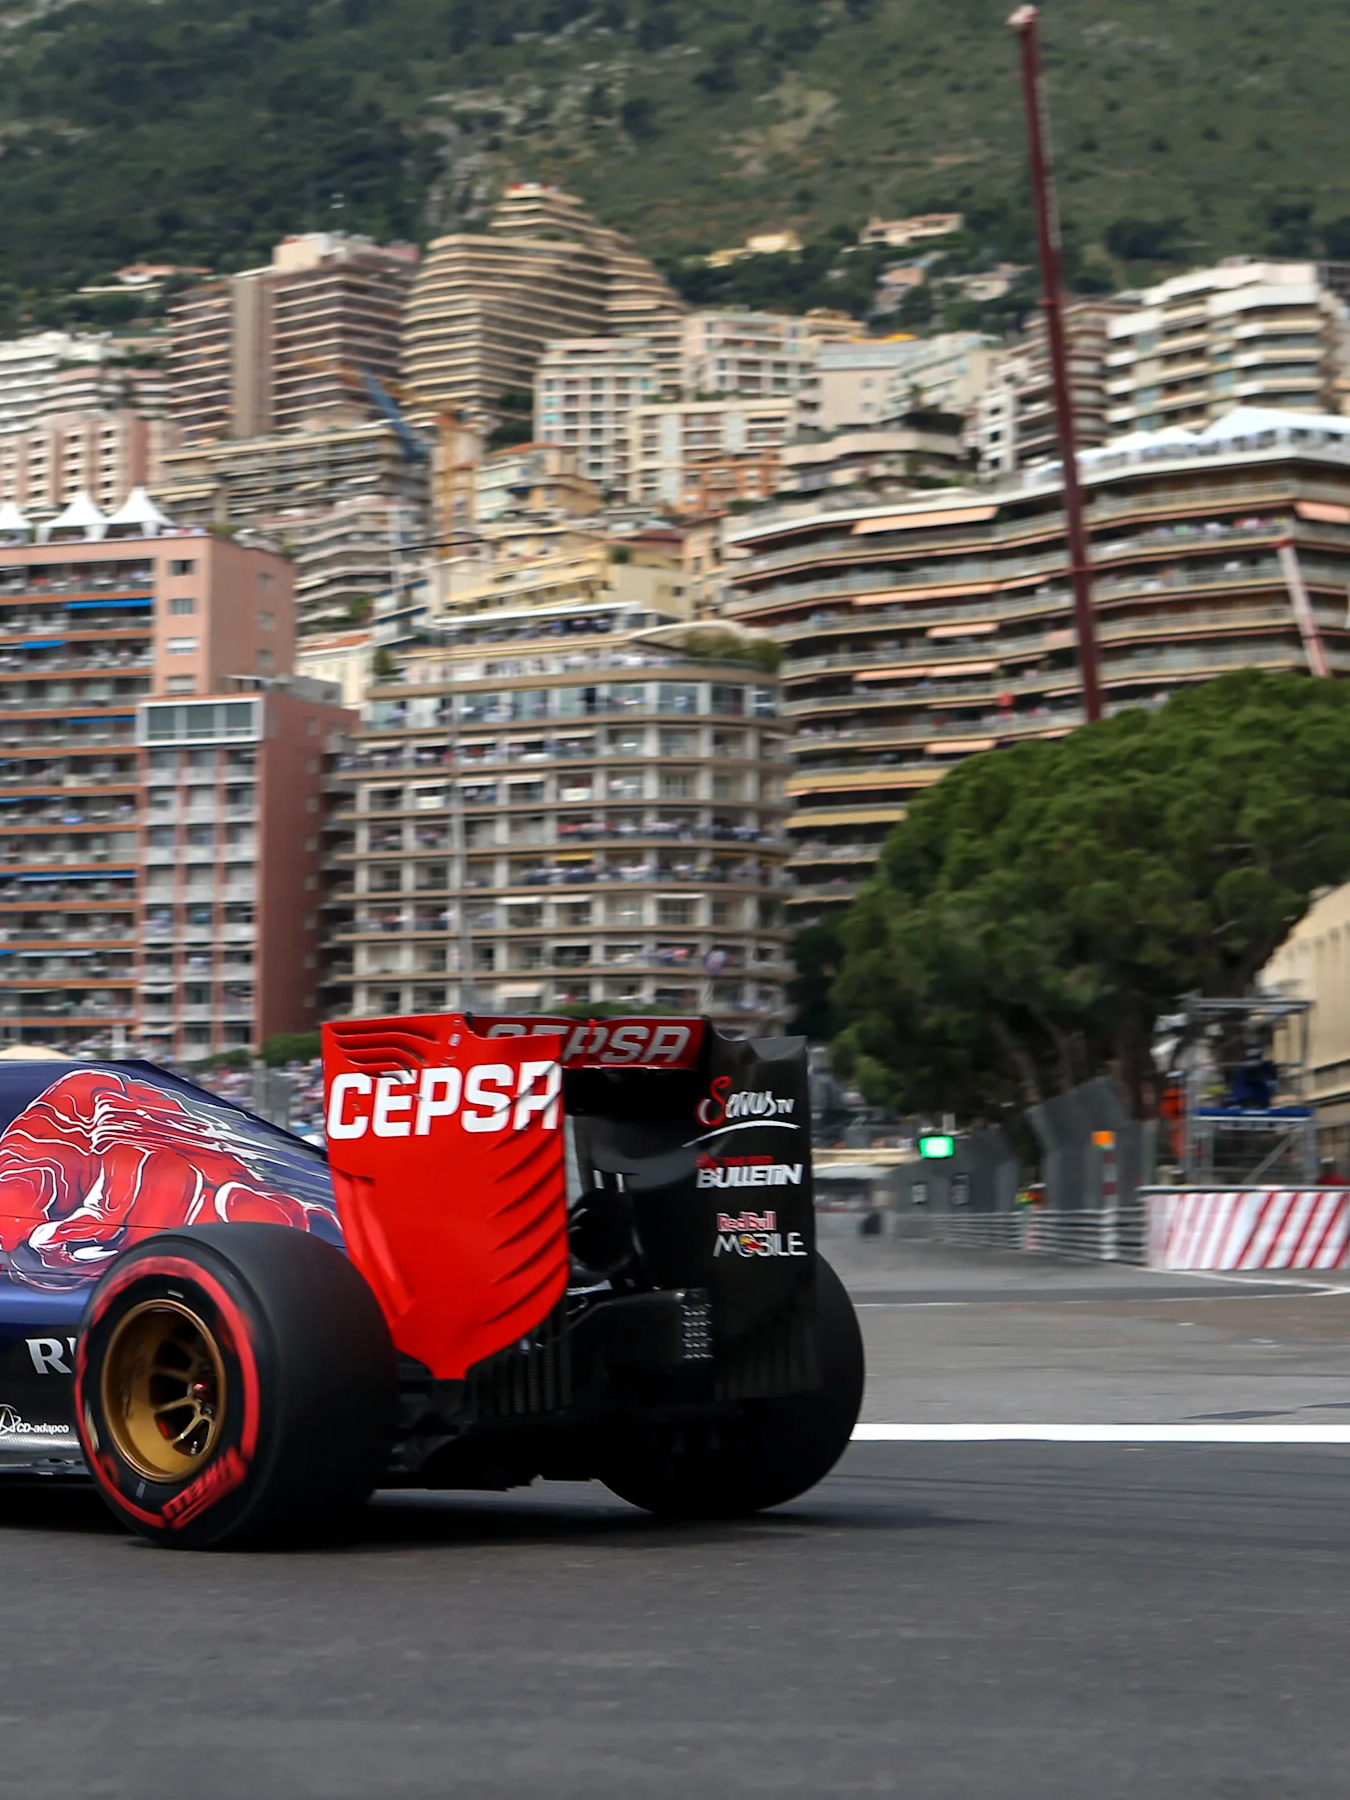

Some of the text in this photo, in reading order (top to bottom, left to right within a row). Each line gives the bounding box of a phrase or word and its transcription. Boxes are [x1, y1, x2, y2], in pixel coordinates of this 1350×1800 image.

[486, 1023, 692, 1064] PSA
[327, 1060, 563, 1140] CEPSA
[696, 1164, 803, 1189] BULLETIN
[713, 1232, 808, 1257] MOBILE
